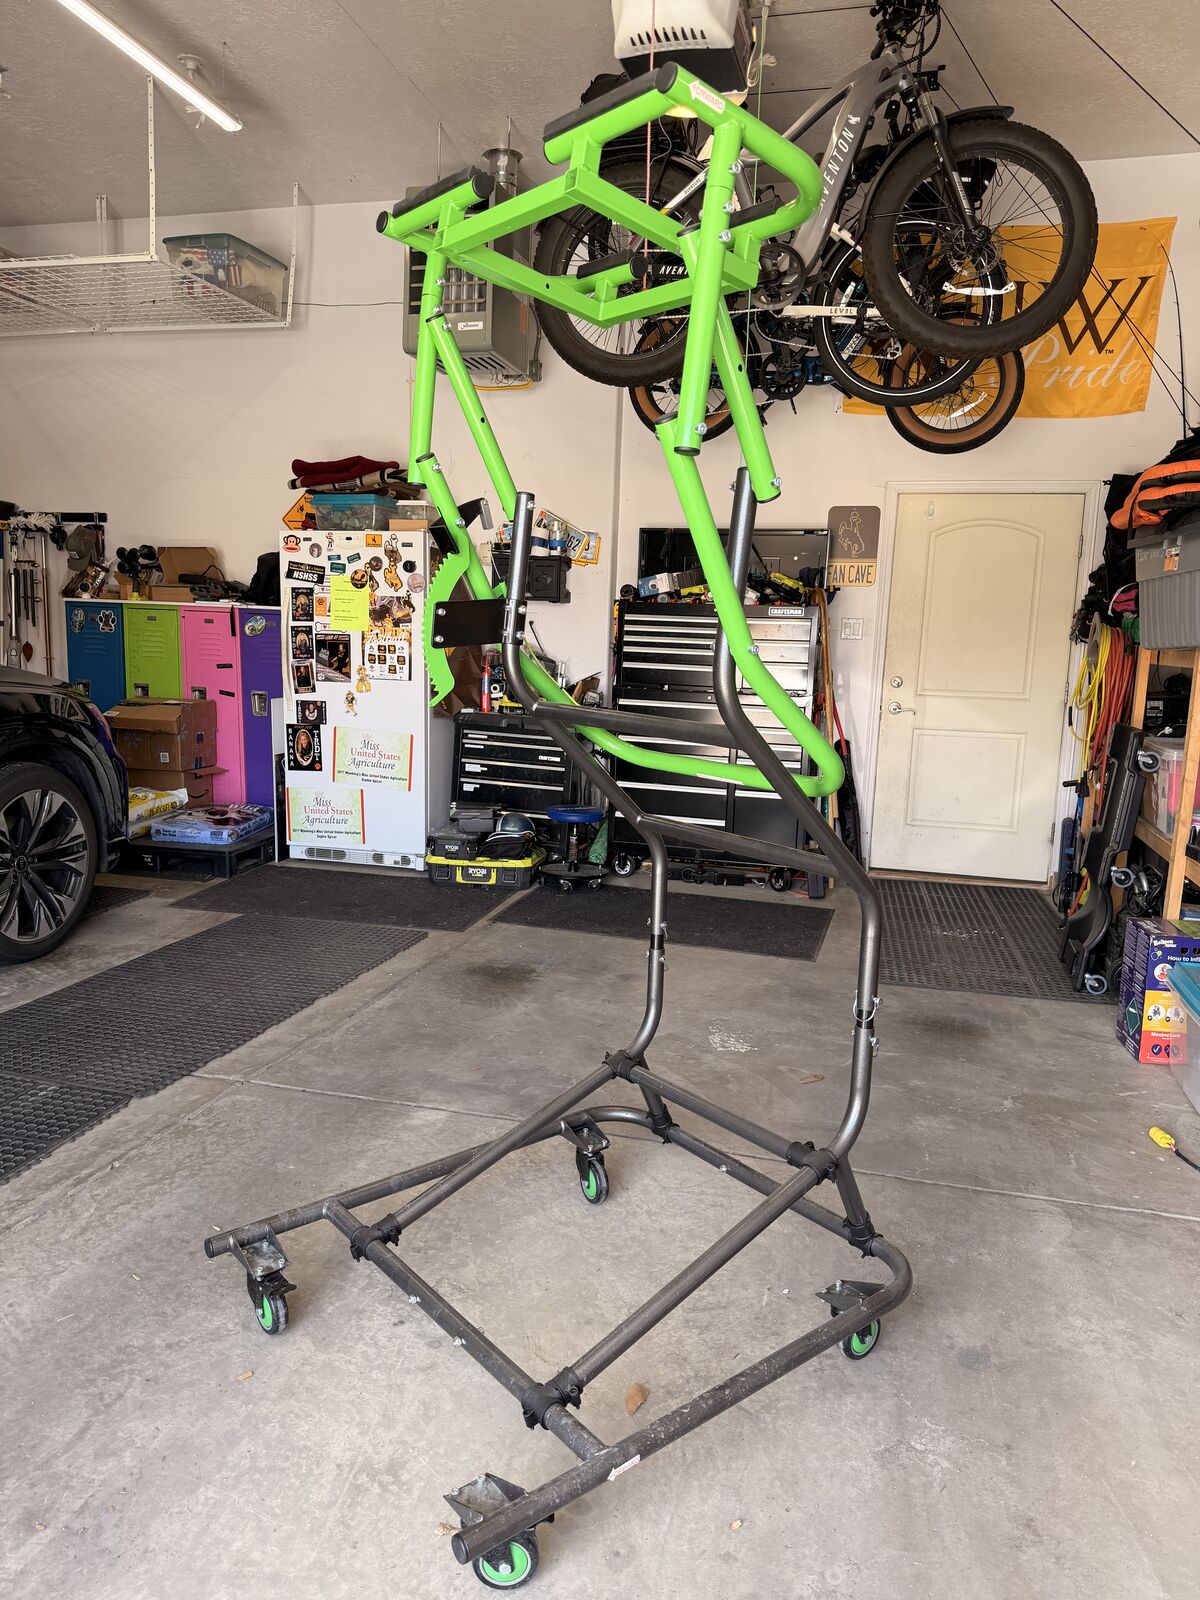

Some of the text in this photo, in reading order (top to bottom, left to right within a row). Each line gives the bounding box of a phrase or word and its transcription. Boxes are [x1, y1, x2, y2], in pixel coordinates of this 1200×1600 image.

[692, 83, 724, 111] FORWARD
[820, 126, 855, 214] VENTON
[1020, 333, 1143, 388] Pride
[293, 570, 319, 582] NSHSS
[828, 564, 874, 583] FAN CAVE
[360, 739, 380, 750] Miss
[350, 747, 401, 761] United States
[347, 757, 396, 770] Agriculture
[313, 797, 332, 807] Miss
[304, 806, 354, 815] United States
[302, 815, 349, 826] Agriculture
